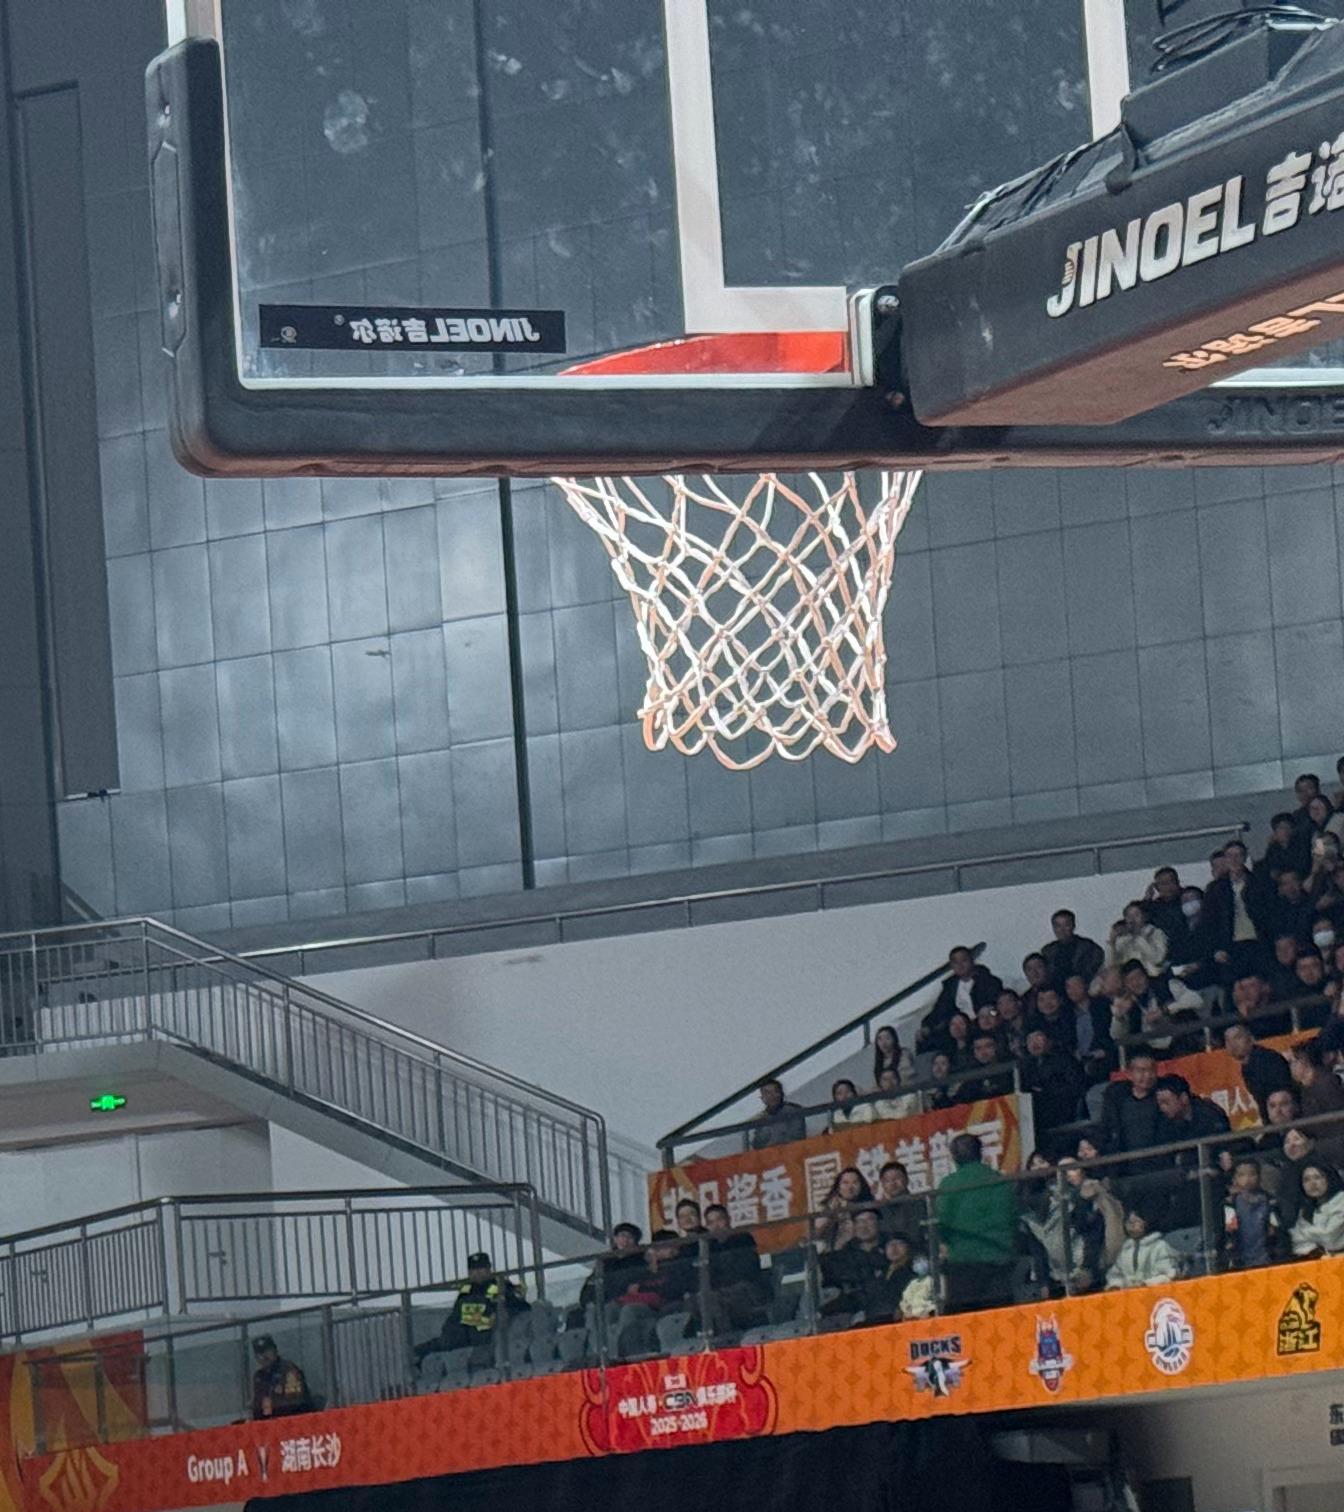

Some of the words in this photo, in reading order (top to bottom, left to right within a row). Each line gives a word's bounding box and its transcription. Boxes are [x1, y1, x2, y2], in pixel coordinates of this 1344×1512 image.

[1047, 175, 1255, 318] JINOEL
[187, 1454, 234, 1485] Group
[237, 1449, 249, 1476] A
[279, 1432, 341, 1473] 湖南长沙
